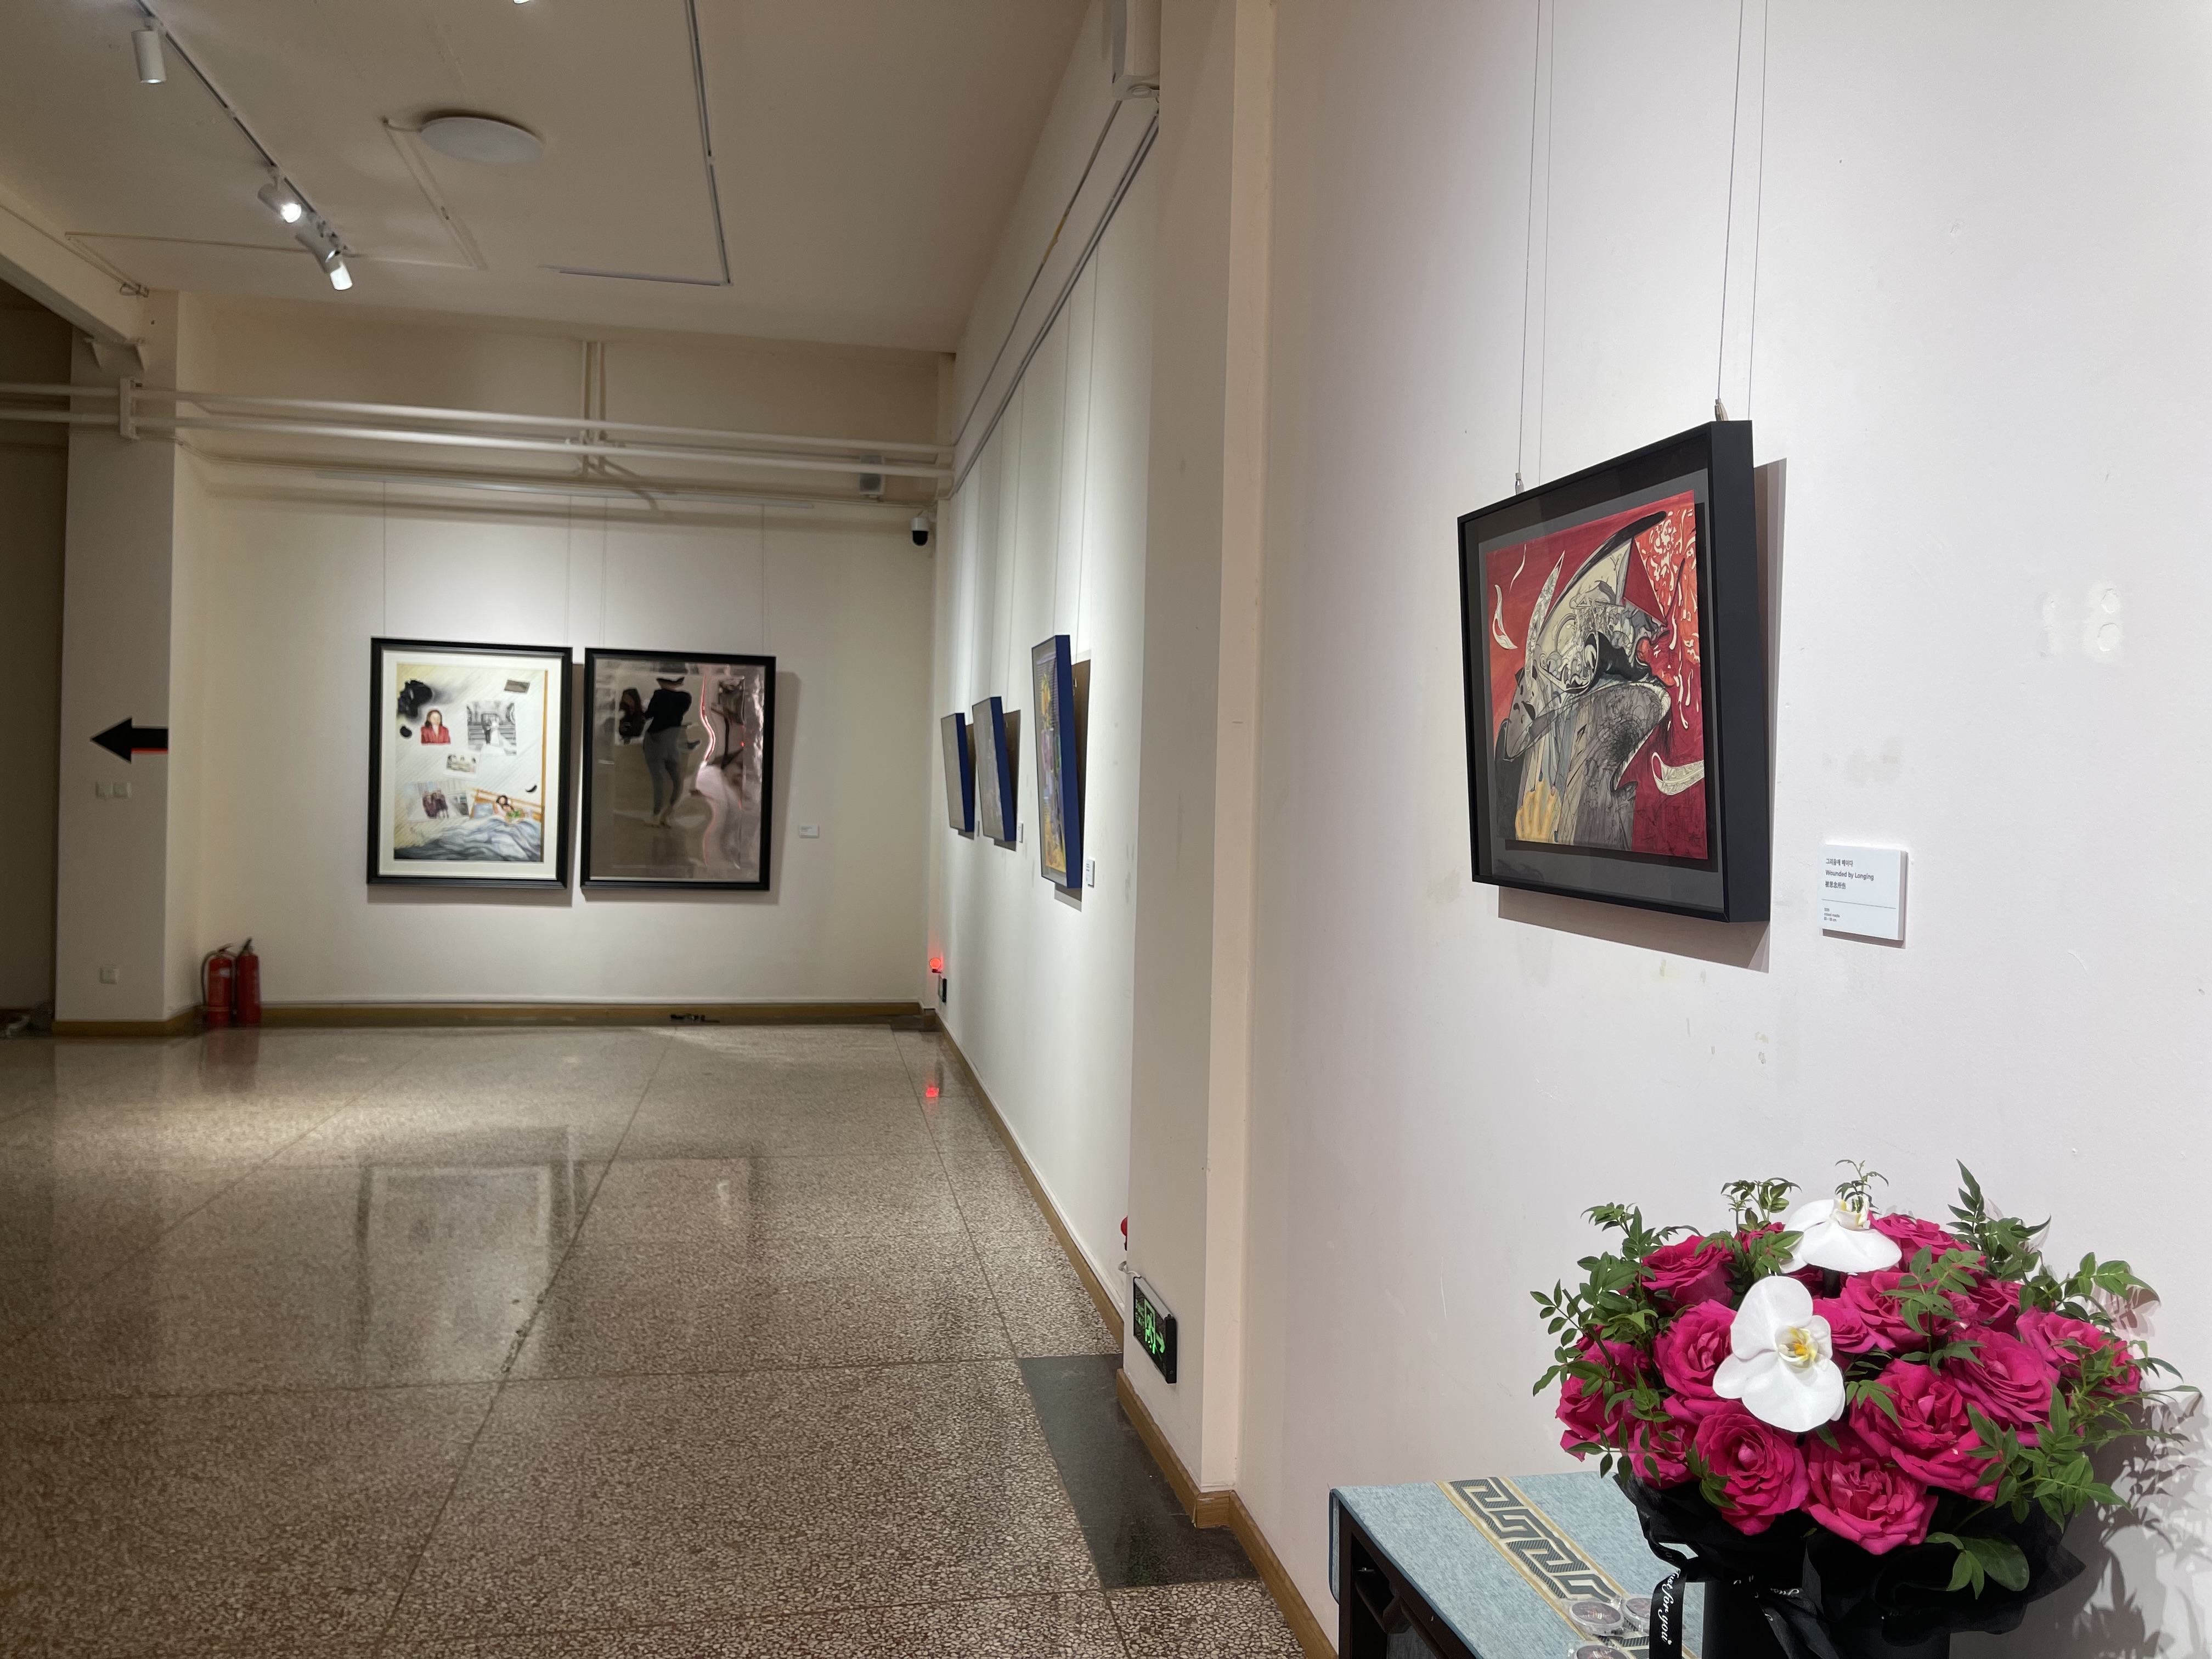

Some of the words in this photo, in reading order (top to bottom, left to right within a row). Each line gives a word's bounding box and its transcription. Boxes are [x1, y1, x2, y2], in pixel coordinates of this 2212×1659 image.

[1855, 872, 1874, 881] Longing
[1662, 1583, 1674, 1613] for
[1658, 1609, 1668, 1643] you
